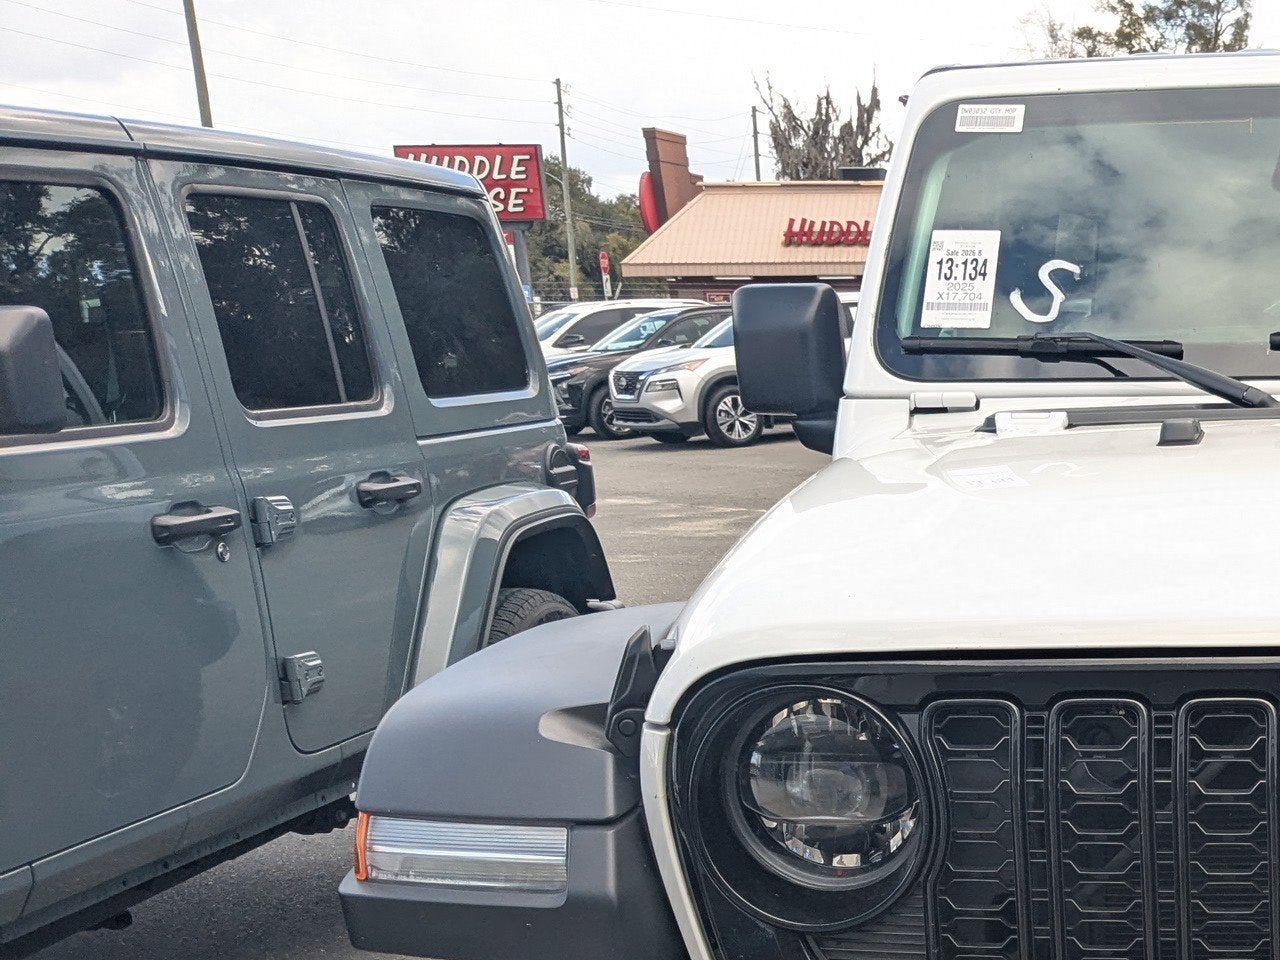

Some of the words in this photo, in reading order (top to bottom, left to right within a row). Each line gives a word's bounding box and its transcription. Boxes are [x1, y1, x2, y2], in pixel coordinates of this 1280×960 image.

[936, 257, 988, 282] 13:134
[947, 282, 975, 292] 2025
[936, 291, 983, 303] X17,704
